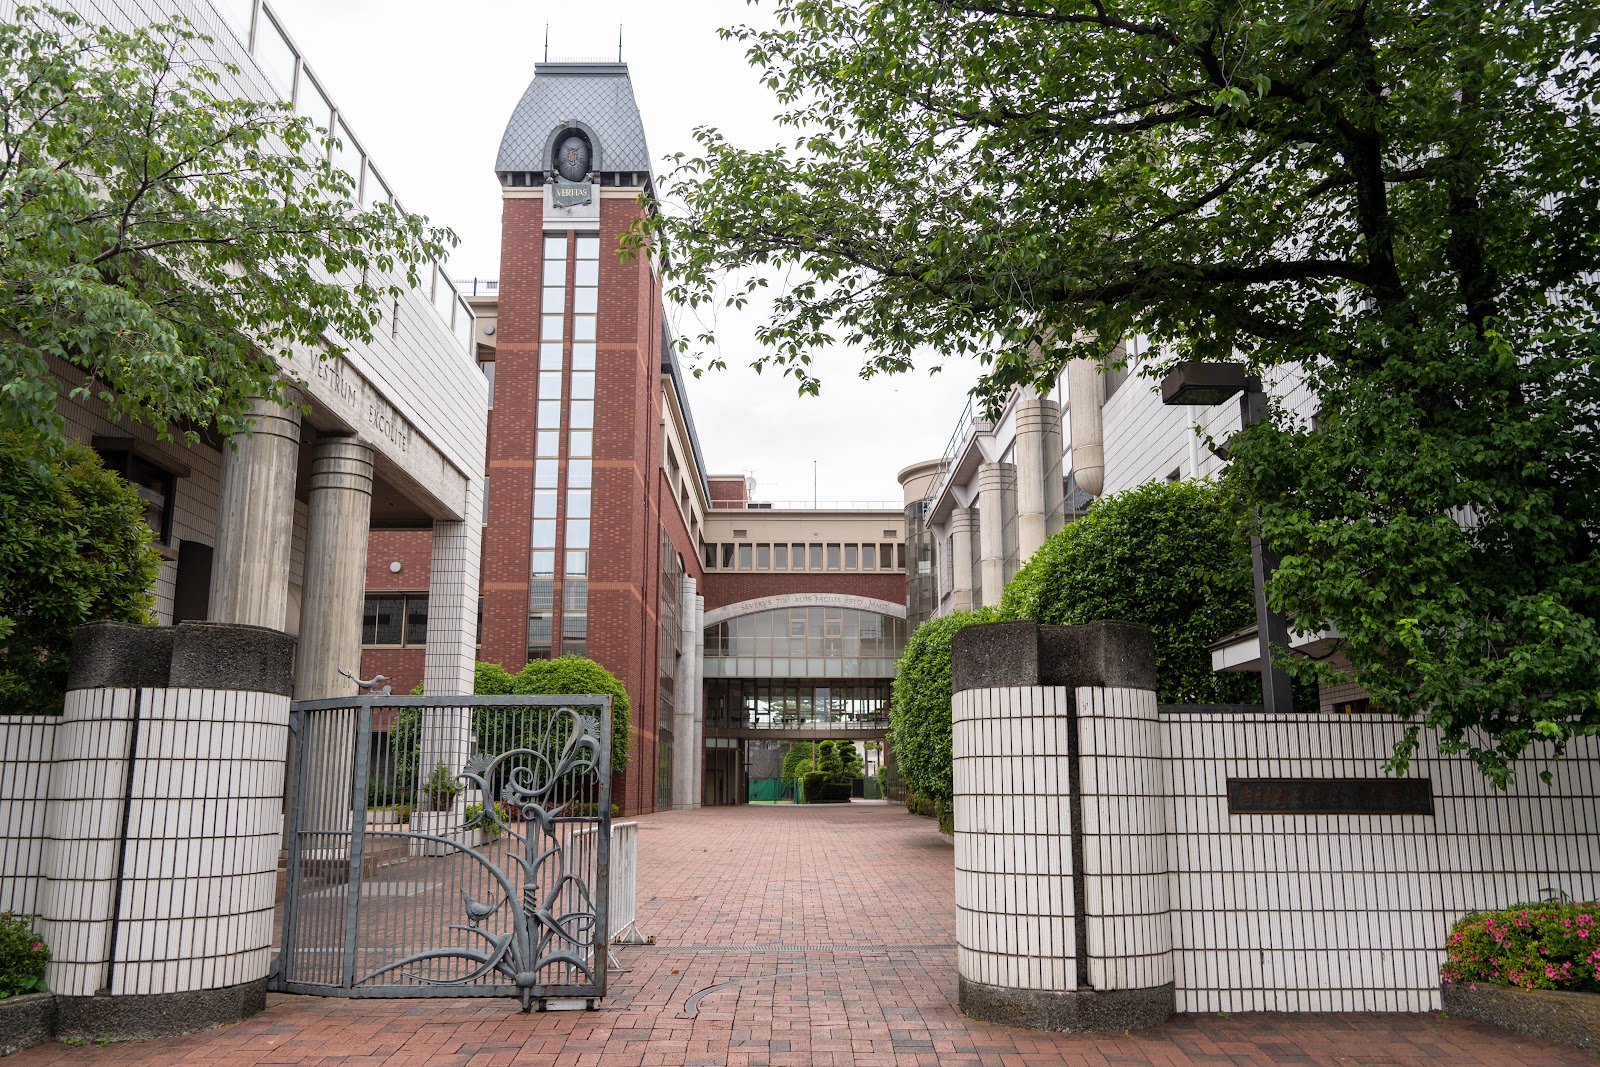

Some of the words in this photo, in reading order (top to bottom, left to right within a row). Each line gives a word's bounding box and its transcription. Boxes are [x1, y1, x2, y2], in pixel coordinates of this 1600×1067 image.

[556, 188, 588, 197] VERITAS
[310, 349, 356, 407] VESTRUM
[368, 404, 406, 452] EXCOLITE
[844, 597, 863, 606] ESTO
